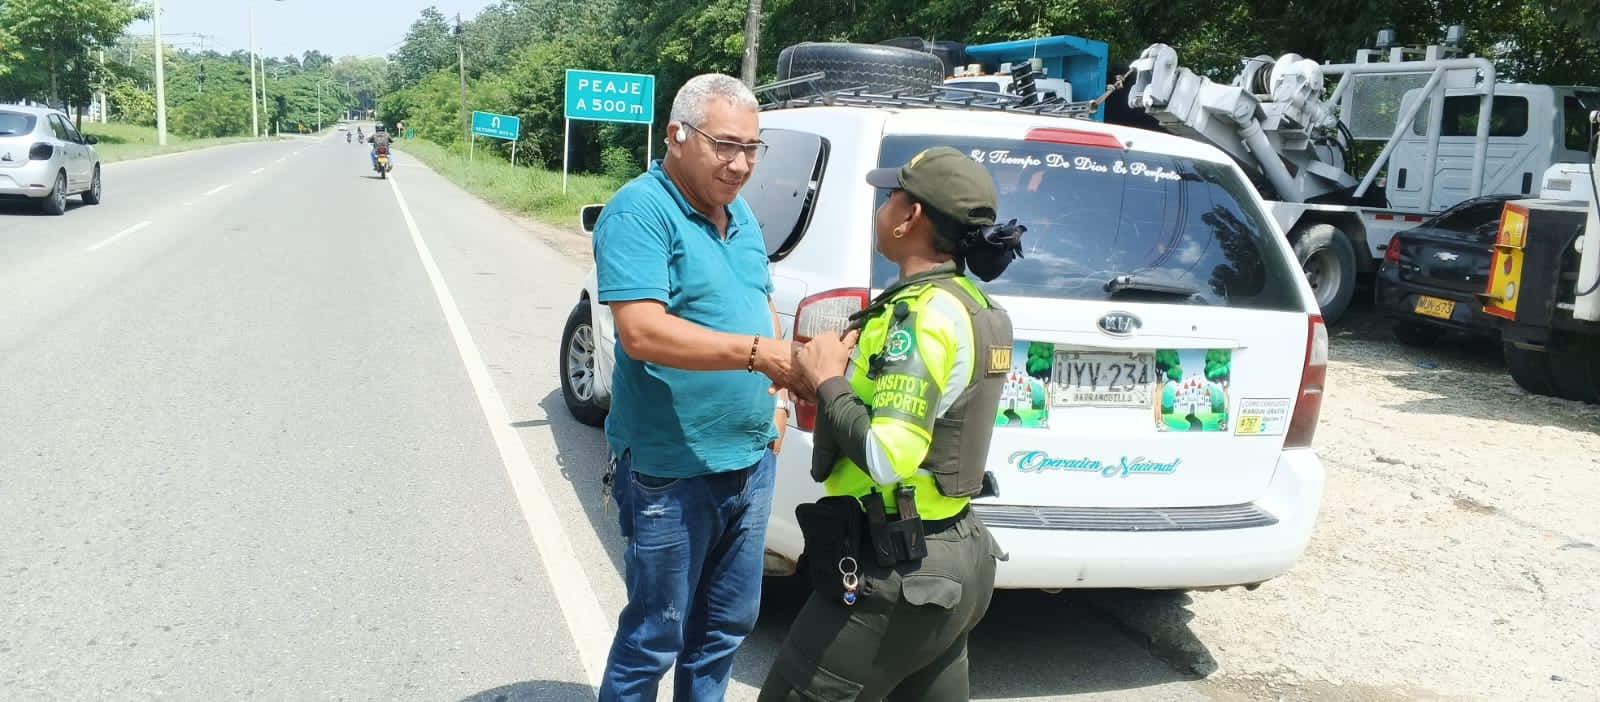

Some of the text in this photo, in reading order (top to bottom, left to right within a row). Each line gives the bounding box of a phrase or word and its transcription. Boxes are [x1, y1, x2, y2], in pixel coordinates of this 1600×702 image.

[578, 79, 641, 95] PEAJE
[576, 98, 643, 115] A 500 m
[988, 150, 1042, 170] Tiempo
[1046, 153, 1070, 169] De
[1074, 156, 1108, 173] Dios
[1130, 161, 1182, 183] Perfecto
